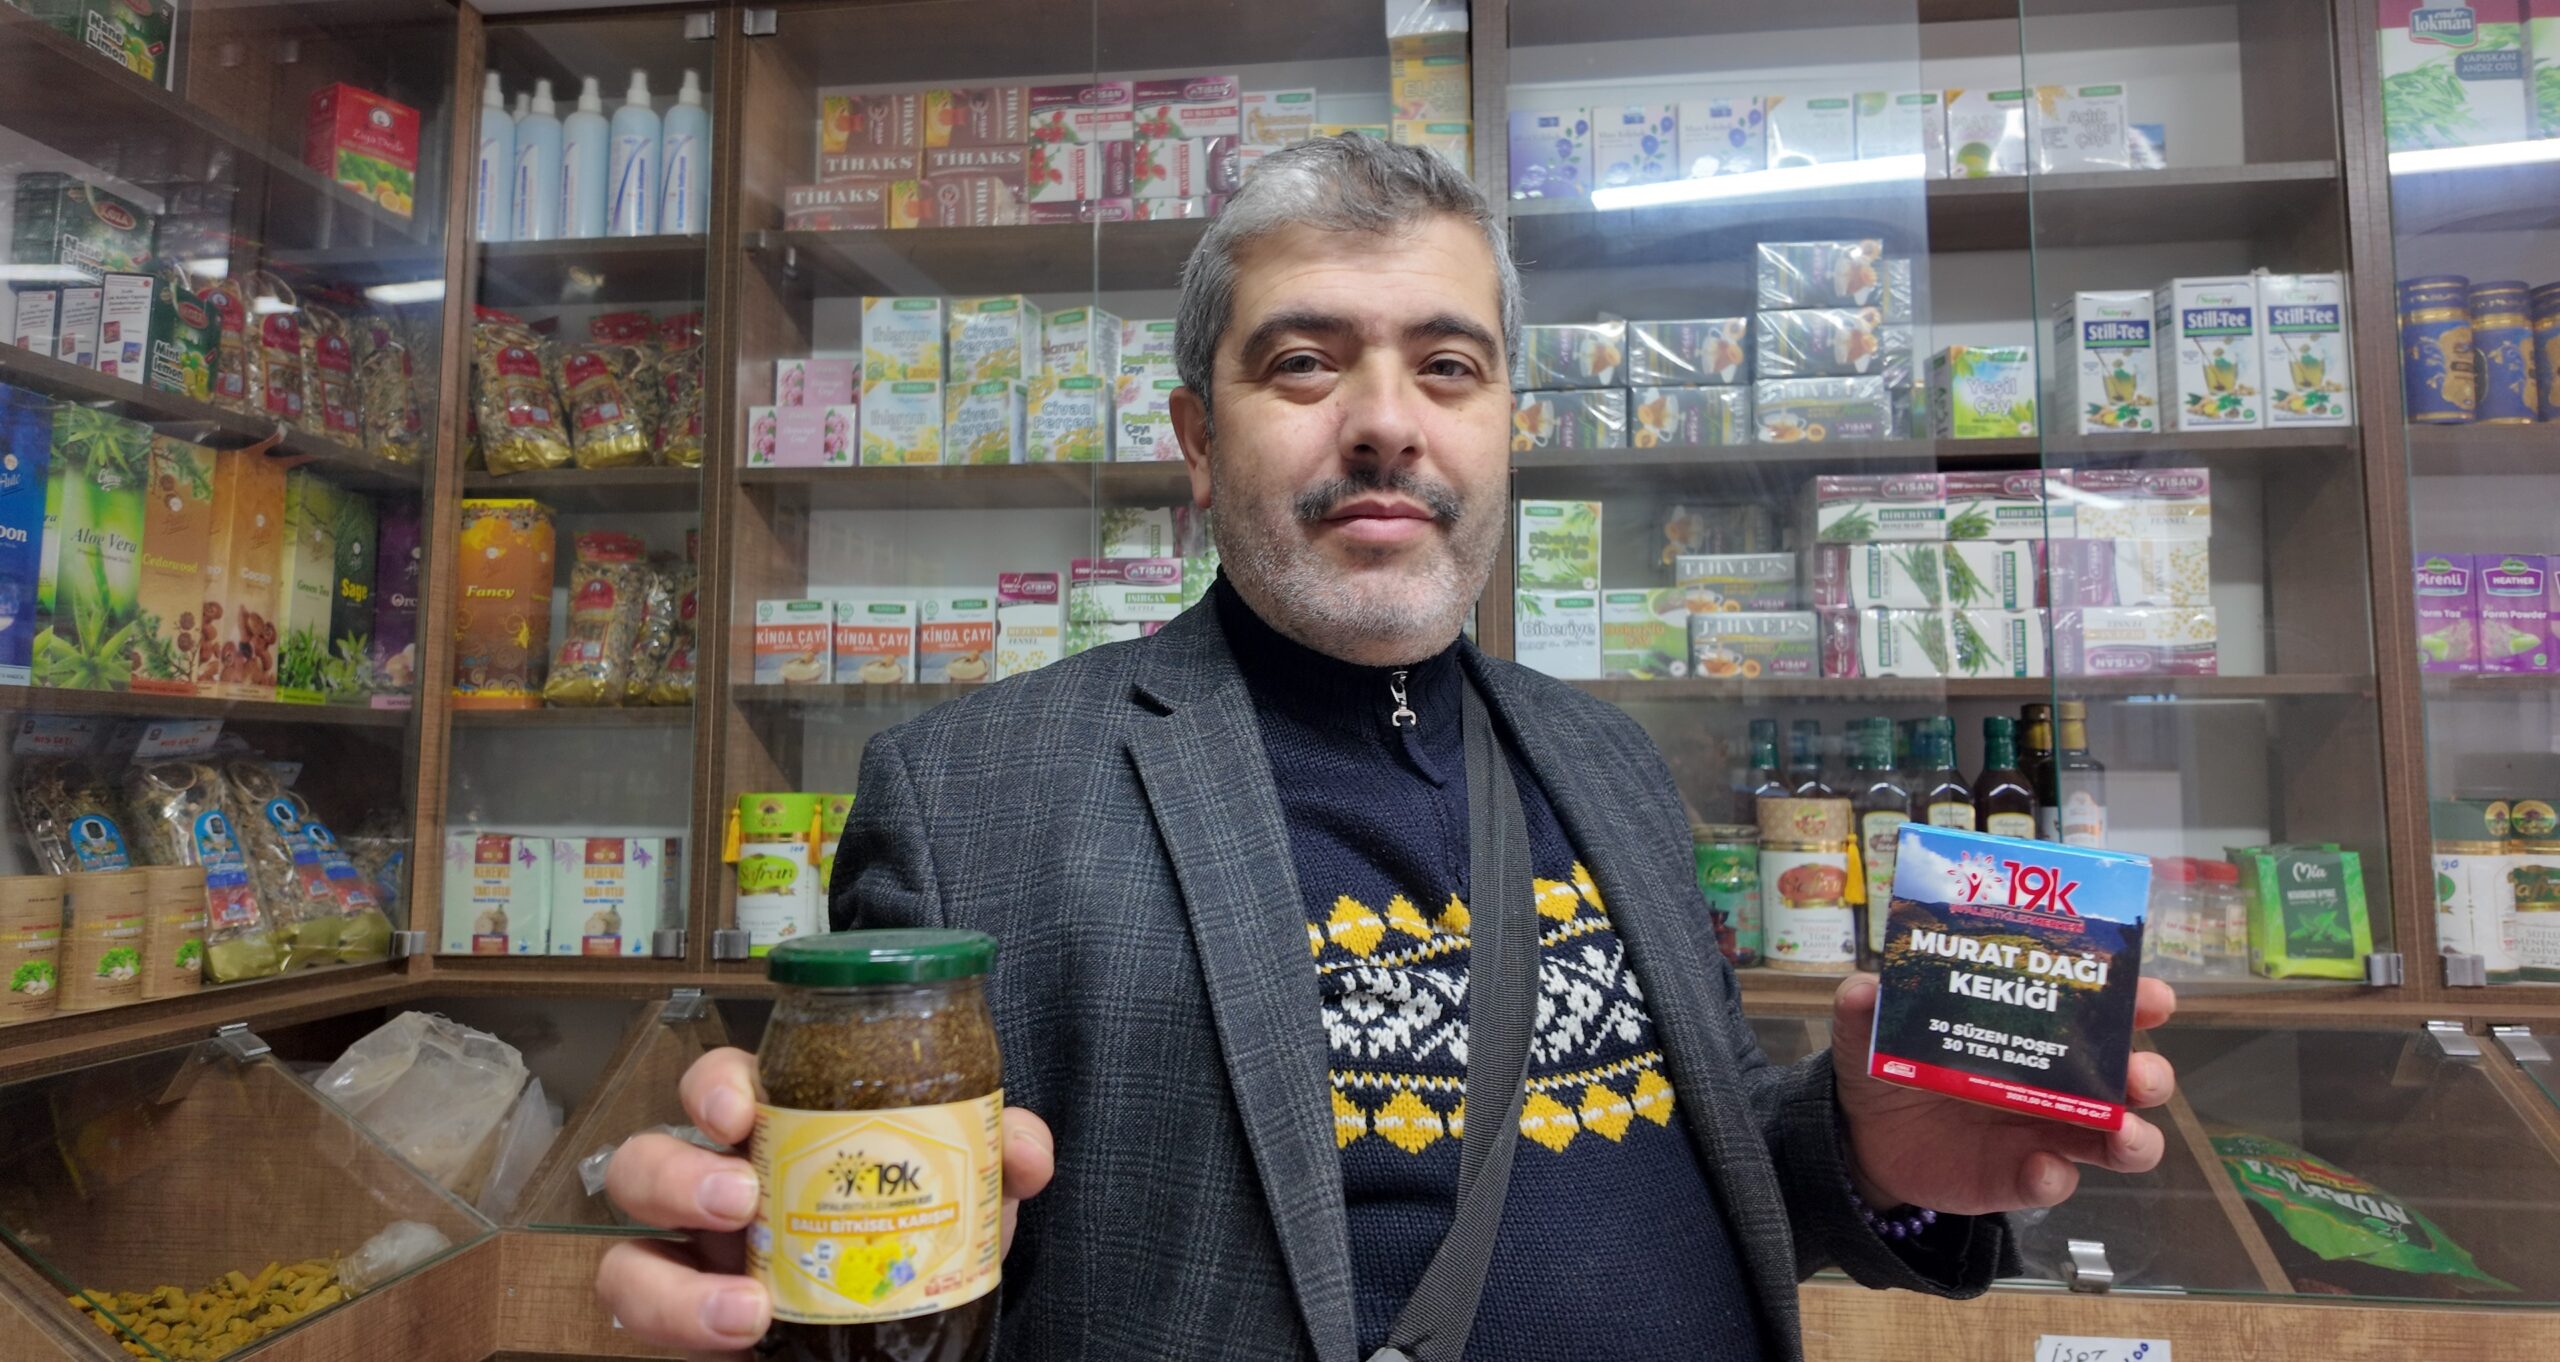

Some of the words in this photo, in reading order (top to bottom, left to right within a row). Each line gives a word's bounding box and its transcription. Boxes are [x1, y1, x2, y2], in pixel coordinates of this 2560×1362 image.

[2414, 13, 2472, 32] lokman
[2495, 63, 2517, 71] OTU
[827, 156, 913, 172] TİHAKS
[933, 151, 1021, 167] TİHAKS
[793, 188, 880, 205] TİHAKS
[2187, 311, 2246, 328] Still-Tee
[2274, 307, 2334, 325] Still-Tee
[2088, 323, 2145, 340] Still-Tee
[155, 341, 180, 361] Mint
[153, 357, 184, 382] lemon
[1967, 377, 2017, 398] Yeşil
[1041, 402, 1091, 417] Civan
[1973, 396, 2011, 417] Çay
[1132, 436, 1153, 446] Tea
[71, 528, 105, 546] Aloe
[109, 533, 137, 553] Vera
[142, 552, 198, 574] Cedarwood
[2493, 576, 2535, 585] HEATHER
[341, 578, 368, 602] Sage
[466, 585, 515, 600] Fancy
[757, 629, 793, 645] KİNOA
[922, 627, 958, 642] KİNOA
[963, 626, 991, 642] ÇAYI
[1523, 620, 1595, 639] Biberiye
[837, 630, 875, 646] KİNOA
[879, 631, 909, 647] ÇAYI
[1910, 929, 2021, 969] MURAT
[2029, 952, 2108, 986] DAĞI
[1949, 970, 2058, 1012] KEKİĞİ
[1929, 1018, 1949, 1033] 30
[1952, 1022, 2010, 1046] SÜZEN
[2011, 1034, 2068, 1058] POŞET
[1942, 1037, 1963, 1052] 30
[1966, 1042, 2000, 1060] TEA
[2002, 1050, 2050, 1071] BAGS
[791, 1216, 828, 1232] BALLI
[830, 1216, 895, 1233] BİTKİSEL
